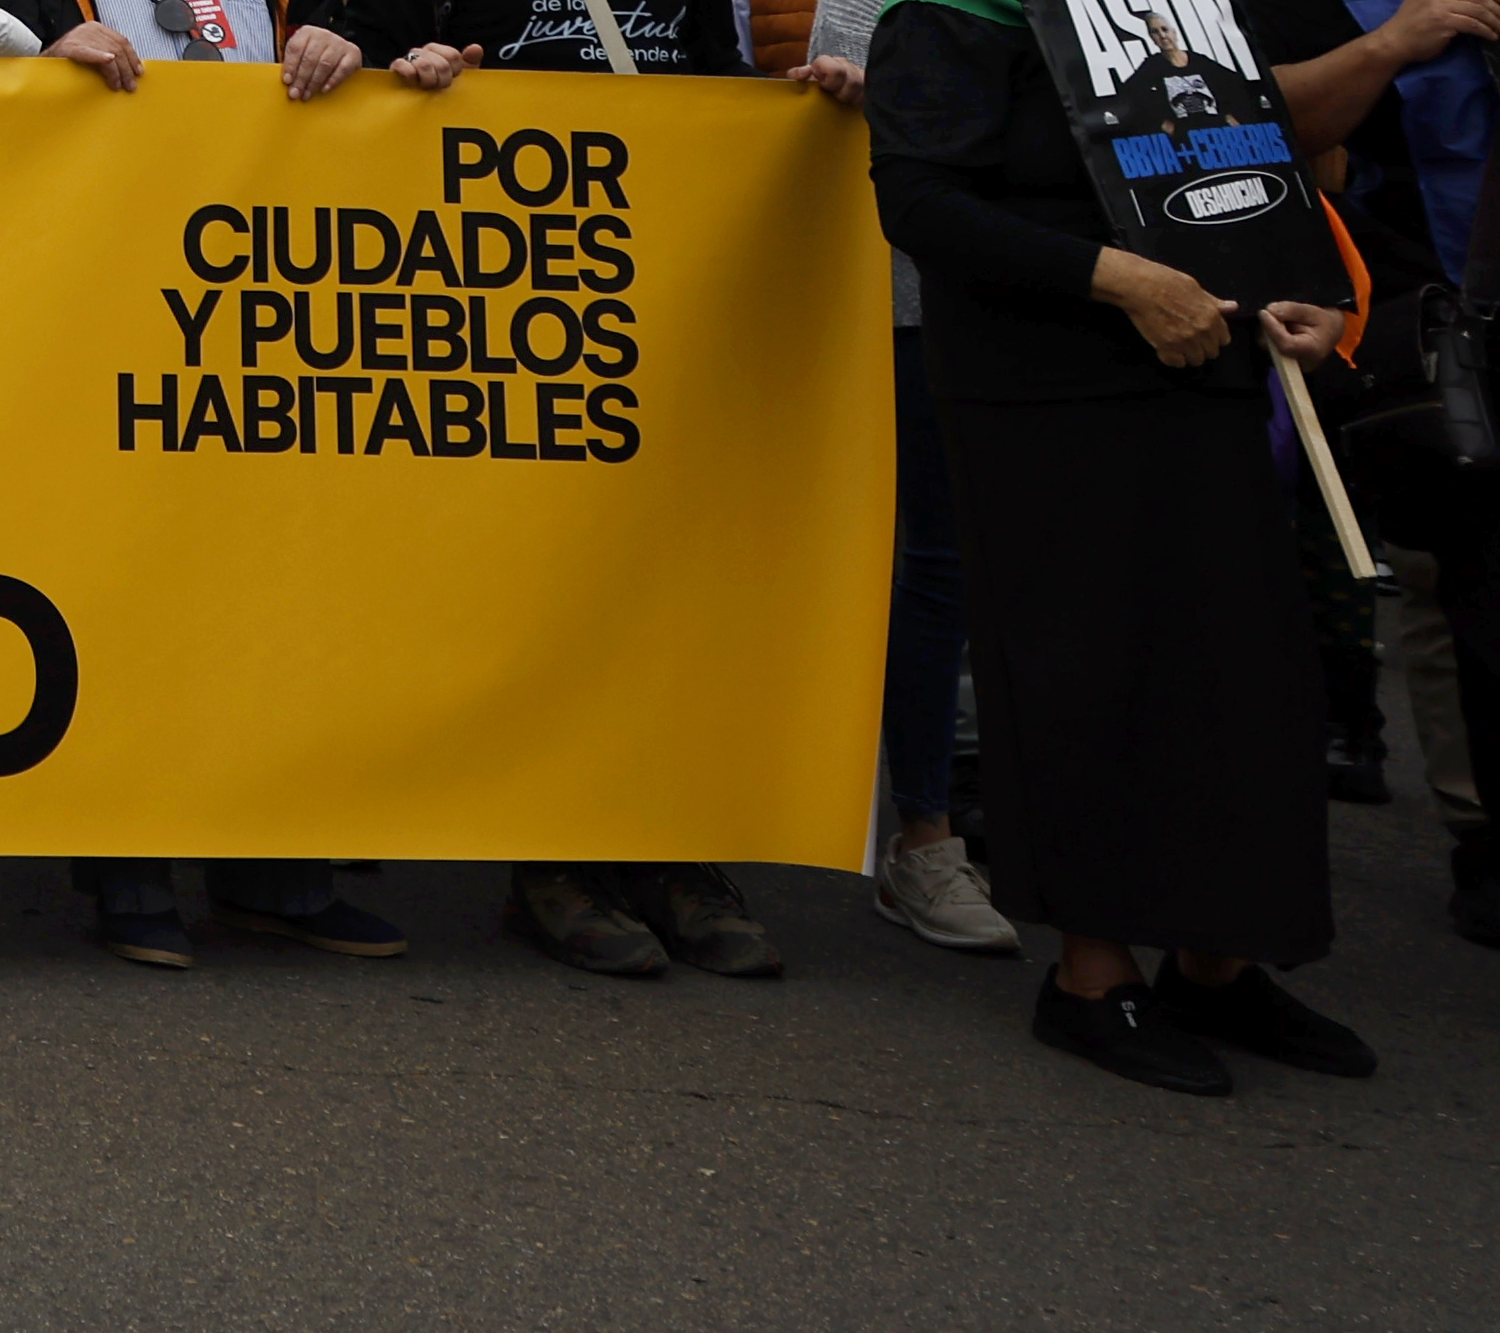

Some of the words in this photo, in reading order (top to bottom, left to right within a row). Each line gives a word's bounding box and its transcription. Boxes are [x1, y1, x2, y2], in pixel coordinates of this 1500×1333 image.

[499, 0, 686, 60] juvetu
[580, 44, 669, 62] deende
[443, 128, 629, 209] POR
[1185, 177, 1270, 219] DESAHUCIAN
[183, 204, 635, 294] CIUDADES
[161, 289, 222, 367] Y
[241, 291, 639, 379] PUEBLOS
[117, 372, 641, 464] HABITABLES
